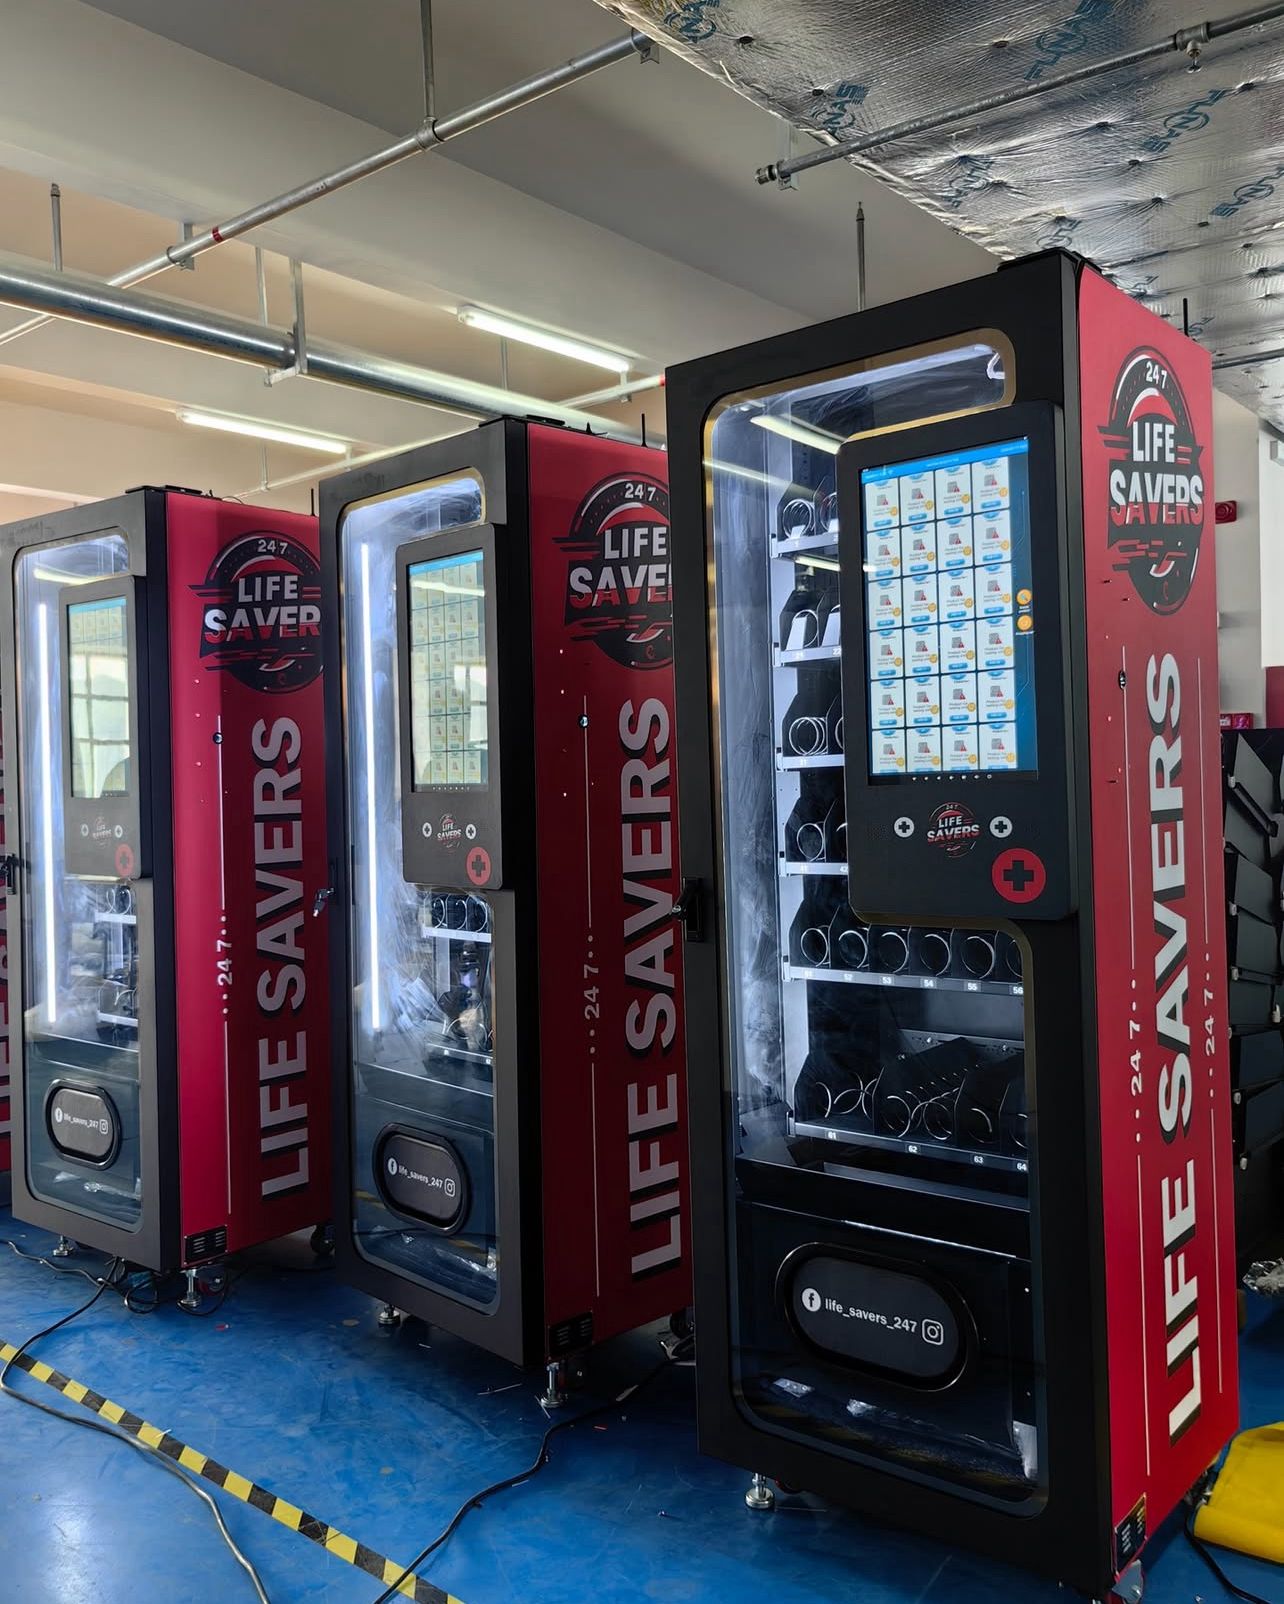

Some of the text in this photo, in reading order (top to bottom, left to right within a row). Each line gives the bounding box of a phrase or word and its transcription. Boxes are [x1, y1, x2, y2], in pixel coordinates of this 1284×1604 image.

[1132, 421, 1175, 463] LIFE
[1110, 469, 1203, 525] SAVERS
[604, 527, 667, 559] LIFE
[238, 575, 298, 603] LIFE
[569, 563, 672, 609] SAVE
[927, 824, 980, 843] SAVERS
[938, 816, 962, 828] LIFE
[252, 717, 309, 1197] LIFE SAVERS
[619, 698, 681, 1275] LIFE SAVERS
[883, 977, 892, 985] 53
[924, 979, 933, 987] 54
[967, 983, 978, 991] 55
[1013, 986, 1023, 994] 56
[1146, 653, 1201, 1436] LIFE SAVERS
[909, 1145, 918, 1153] 62
[974, 1155, 983, 1164] 63
[1017, 1162, 1027, 1171] 64
[825, 1298, 917, 1333] life_savers_247
